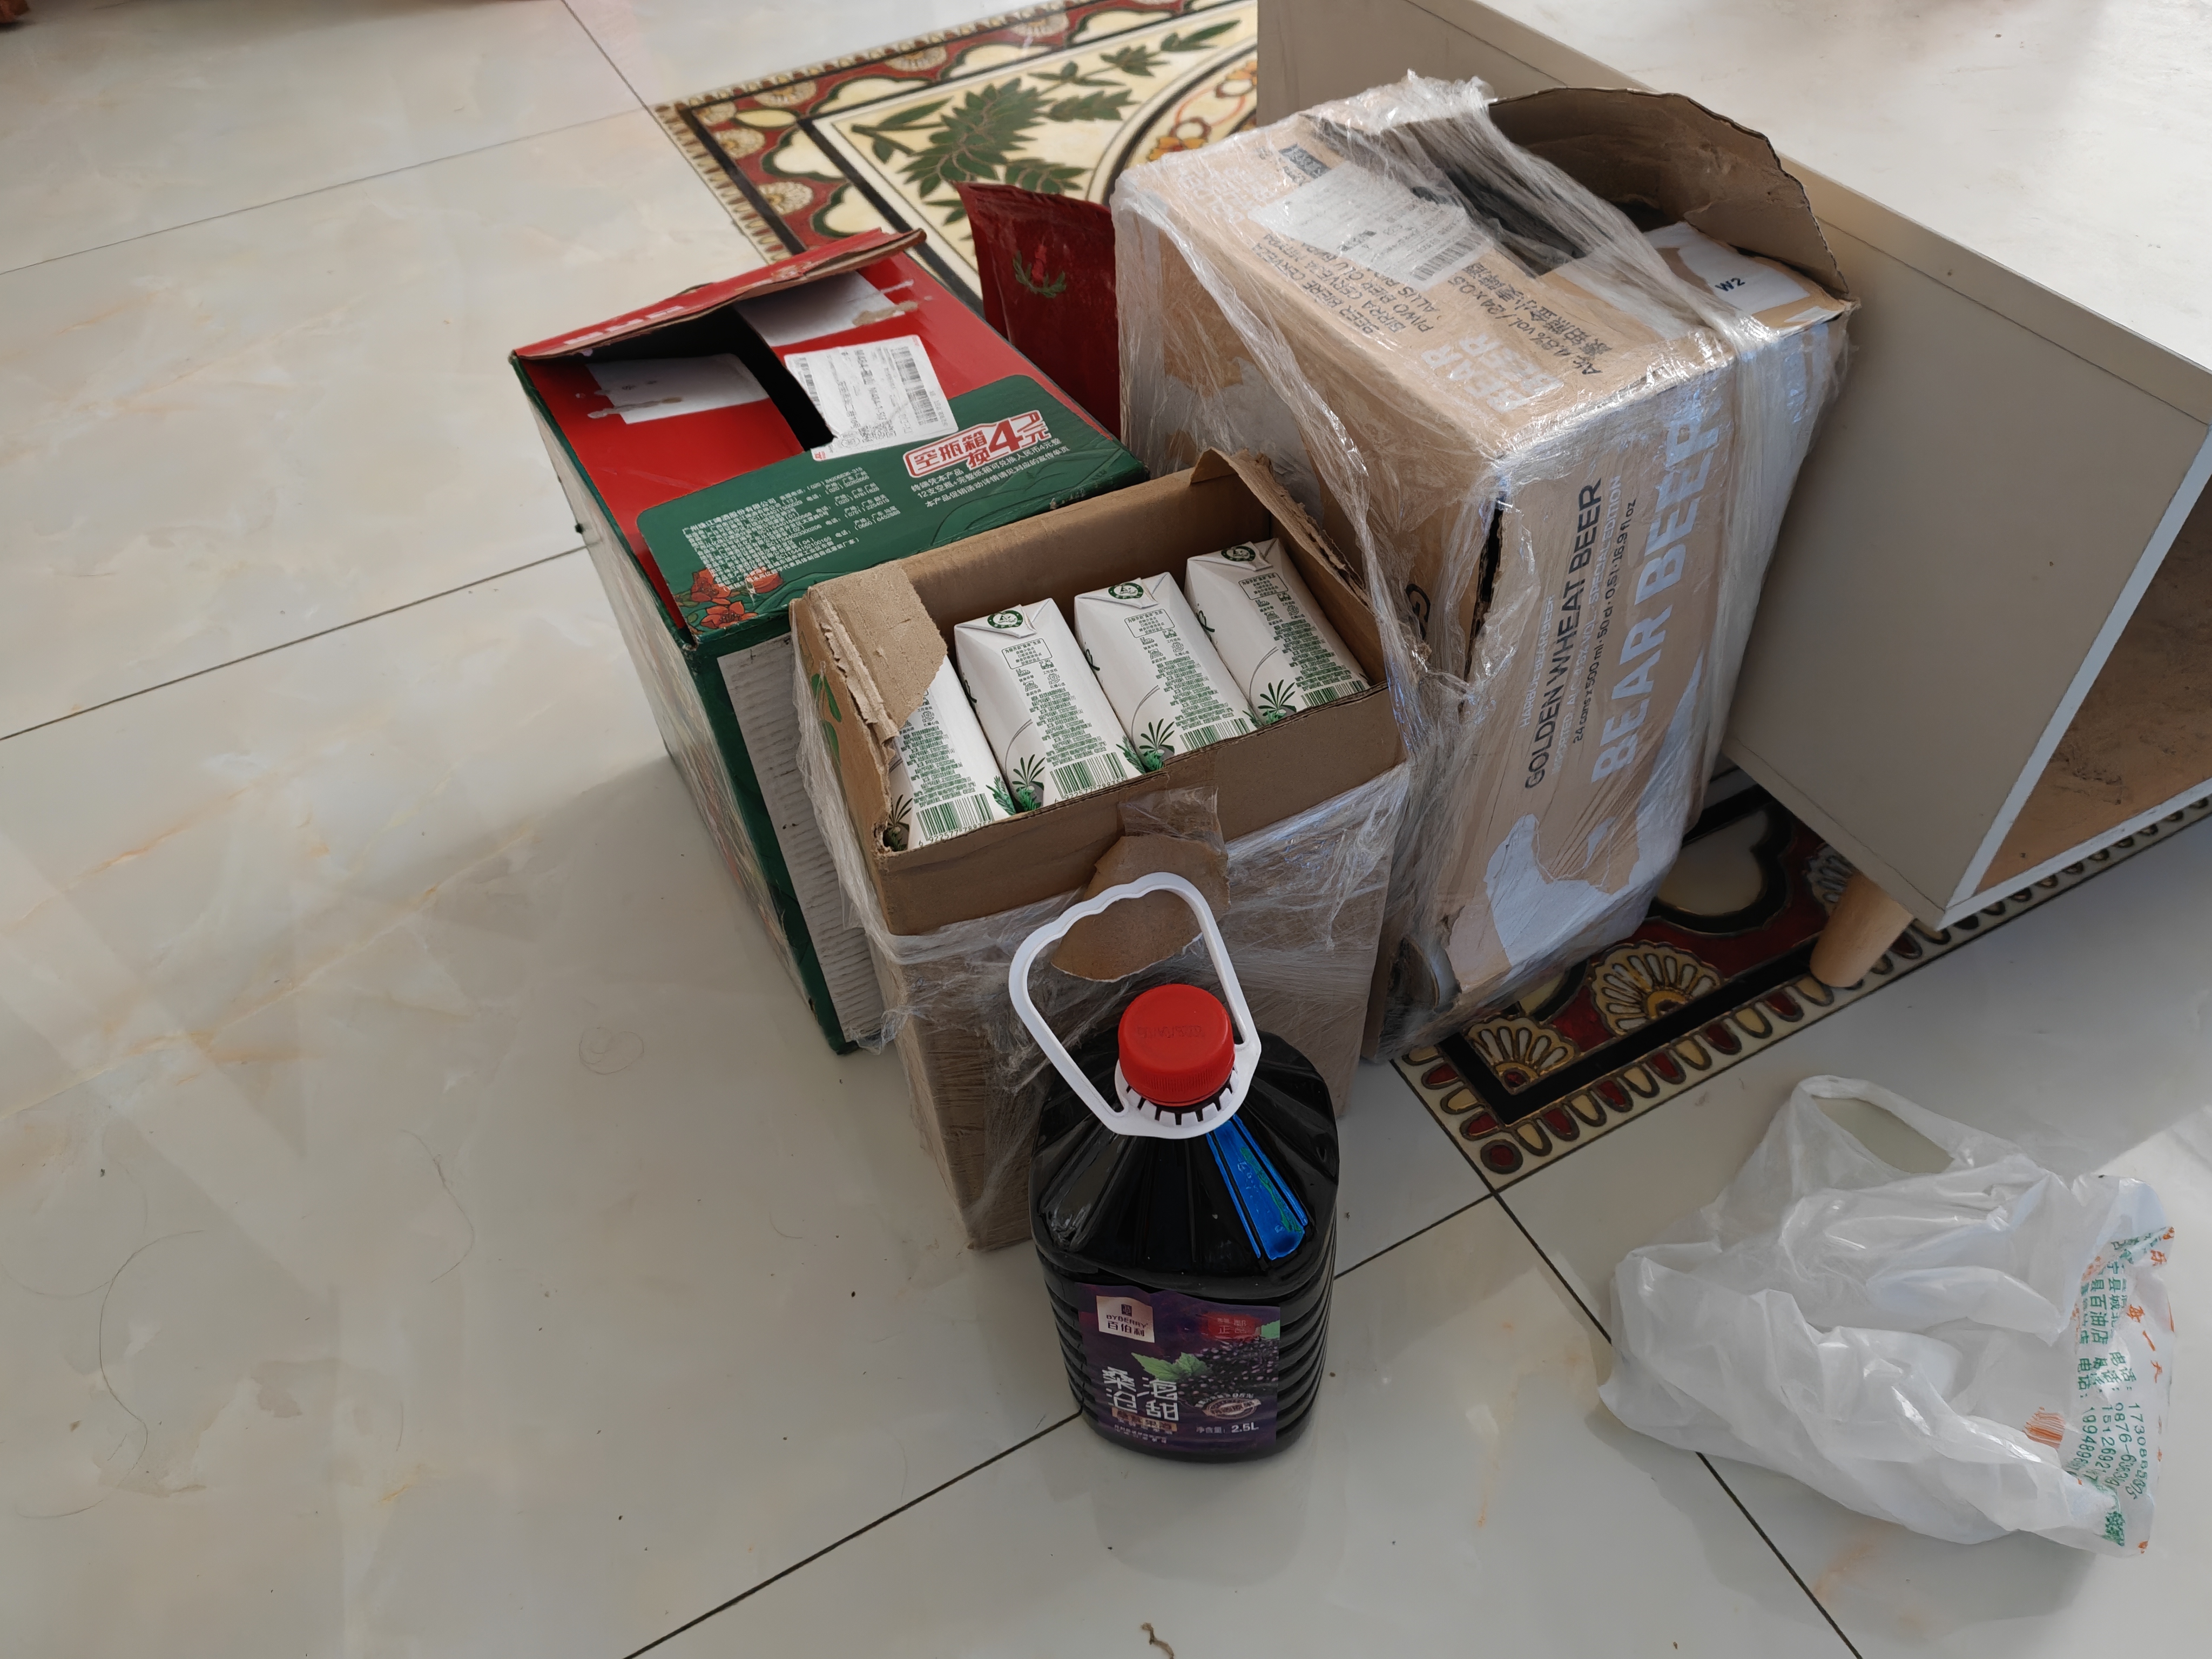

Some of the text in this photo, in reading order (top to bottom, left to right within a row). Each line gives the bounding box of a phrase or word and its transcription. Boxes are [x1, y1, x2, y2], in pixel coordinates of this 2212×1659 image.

[1716, 277, 1745, 293] W2
[1361, 300, 1406, 333] BIRRA
[1391, 301, 1434, 334] PIWO
[1419, 342, 1531, 415] BEAR
[1602, 476, 1621, 540] EDITION
[1526, 478, 1602, 788] GOLDEN WHEAT BEER
[1573, 726, 1584, 743] 24
[1579, 698, 1590, 724] cans
[1626, 500, 1635, 516] oz
[1591, 604, 1672, 783] BEAR
[1107, 1314, 1147, 1327] BYBERRY
[1107, 1321, 1145, 1337] 百伯利
[1232, 1425, 1258, 1433] 2.5L
